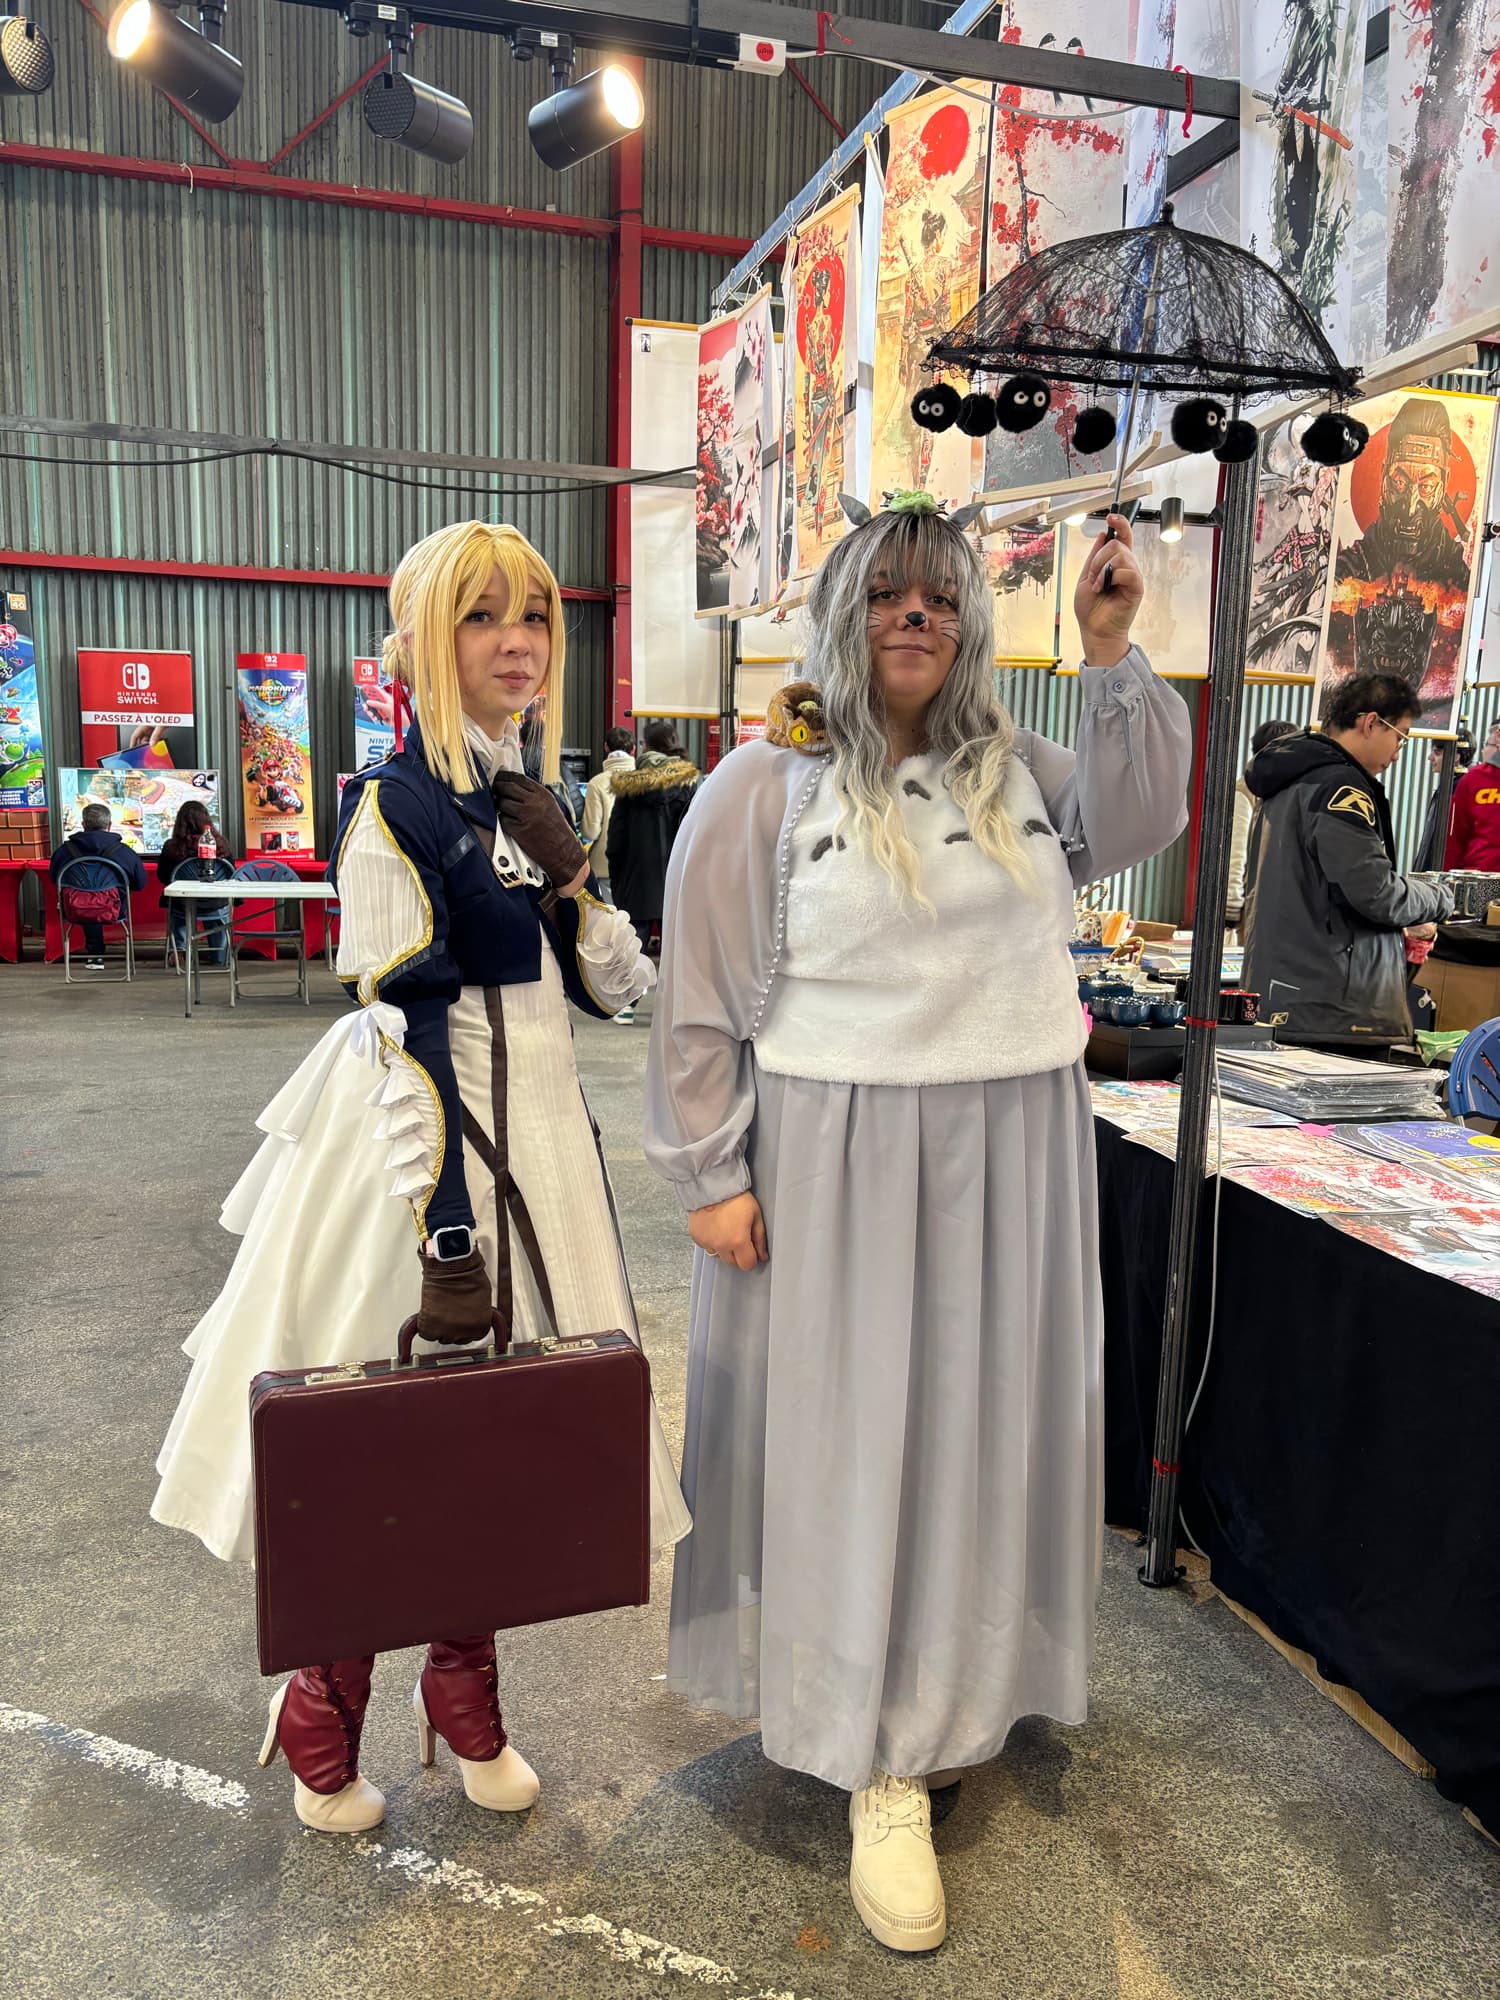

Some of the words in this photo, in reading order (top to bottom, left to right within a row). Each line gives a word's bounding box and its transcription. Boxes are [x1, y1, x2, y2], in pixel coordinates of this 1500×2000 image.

[117, 697, 157, 705] SWITCH
[93, 714, 133, 723] PASSEZ
[135, 712, 143, 723] À
